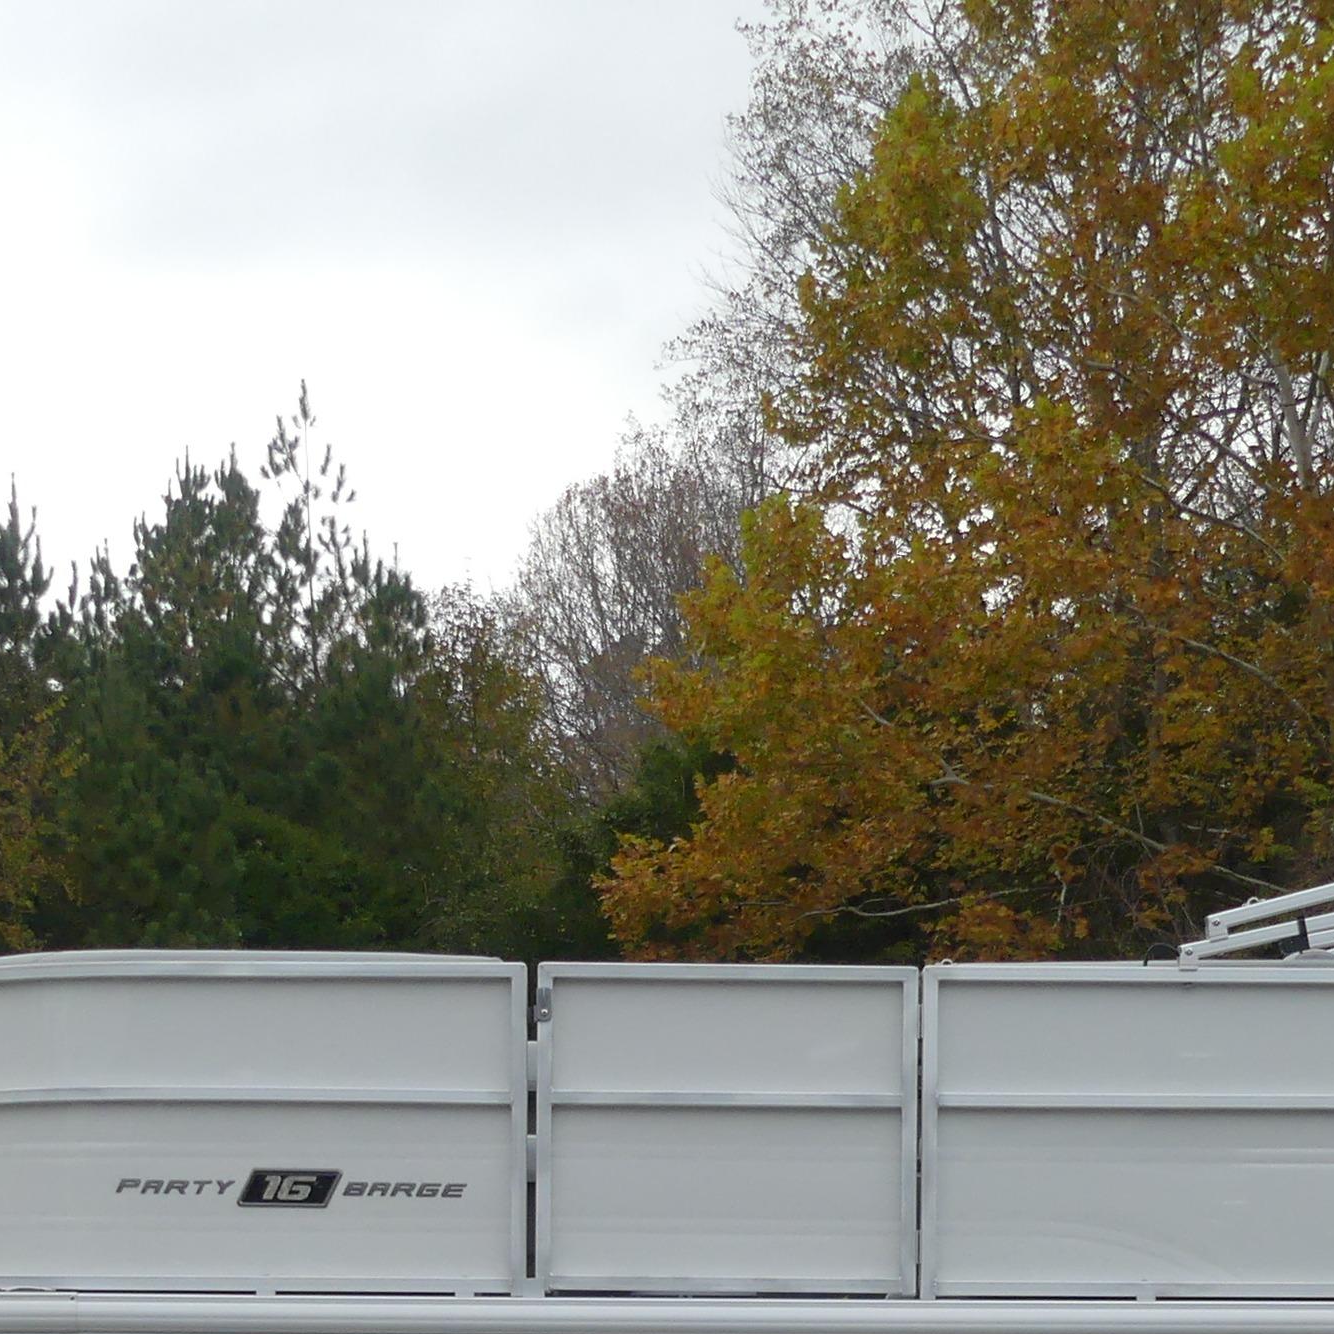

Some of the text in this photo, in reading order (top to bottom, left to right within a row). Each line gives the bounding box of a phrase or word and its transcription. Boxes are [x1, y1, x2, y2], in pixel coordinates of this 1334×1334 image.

[115, 1175, 468, 1201] PARTY 16 BARGE
